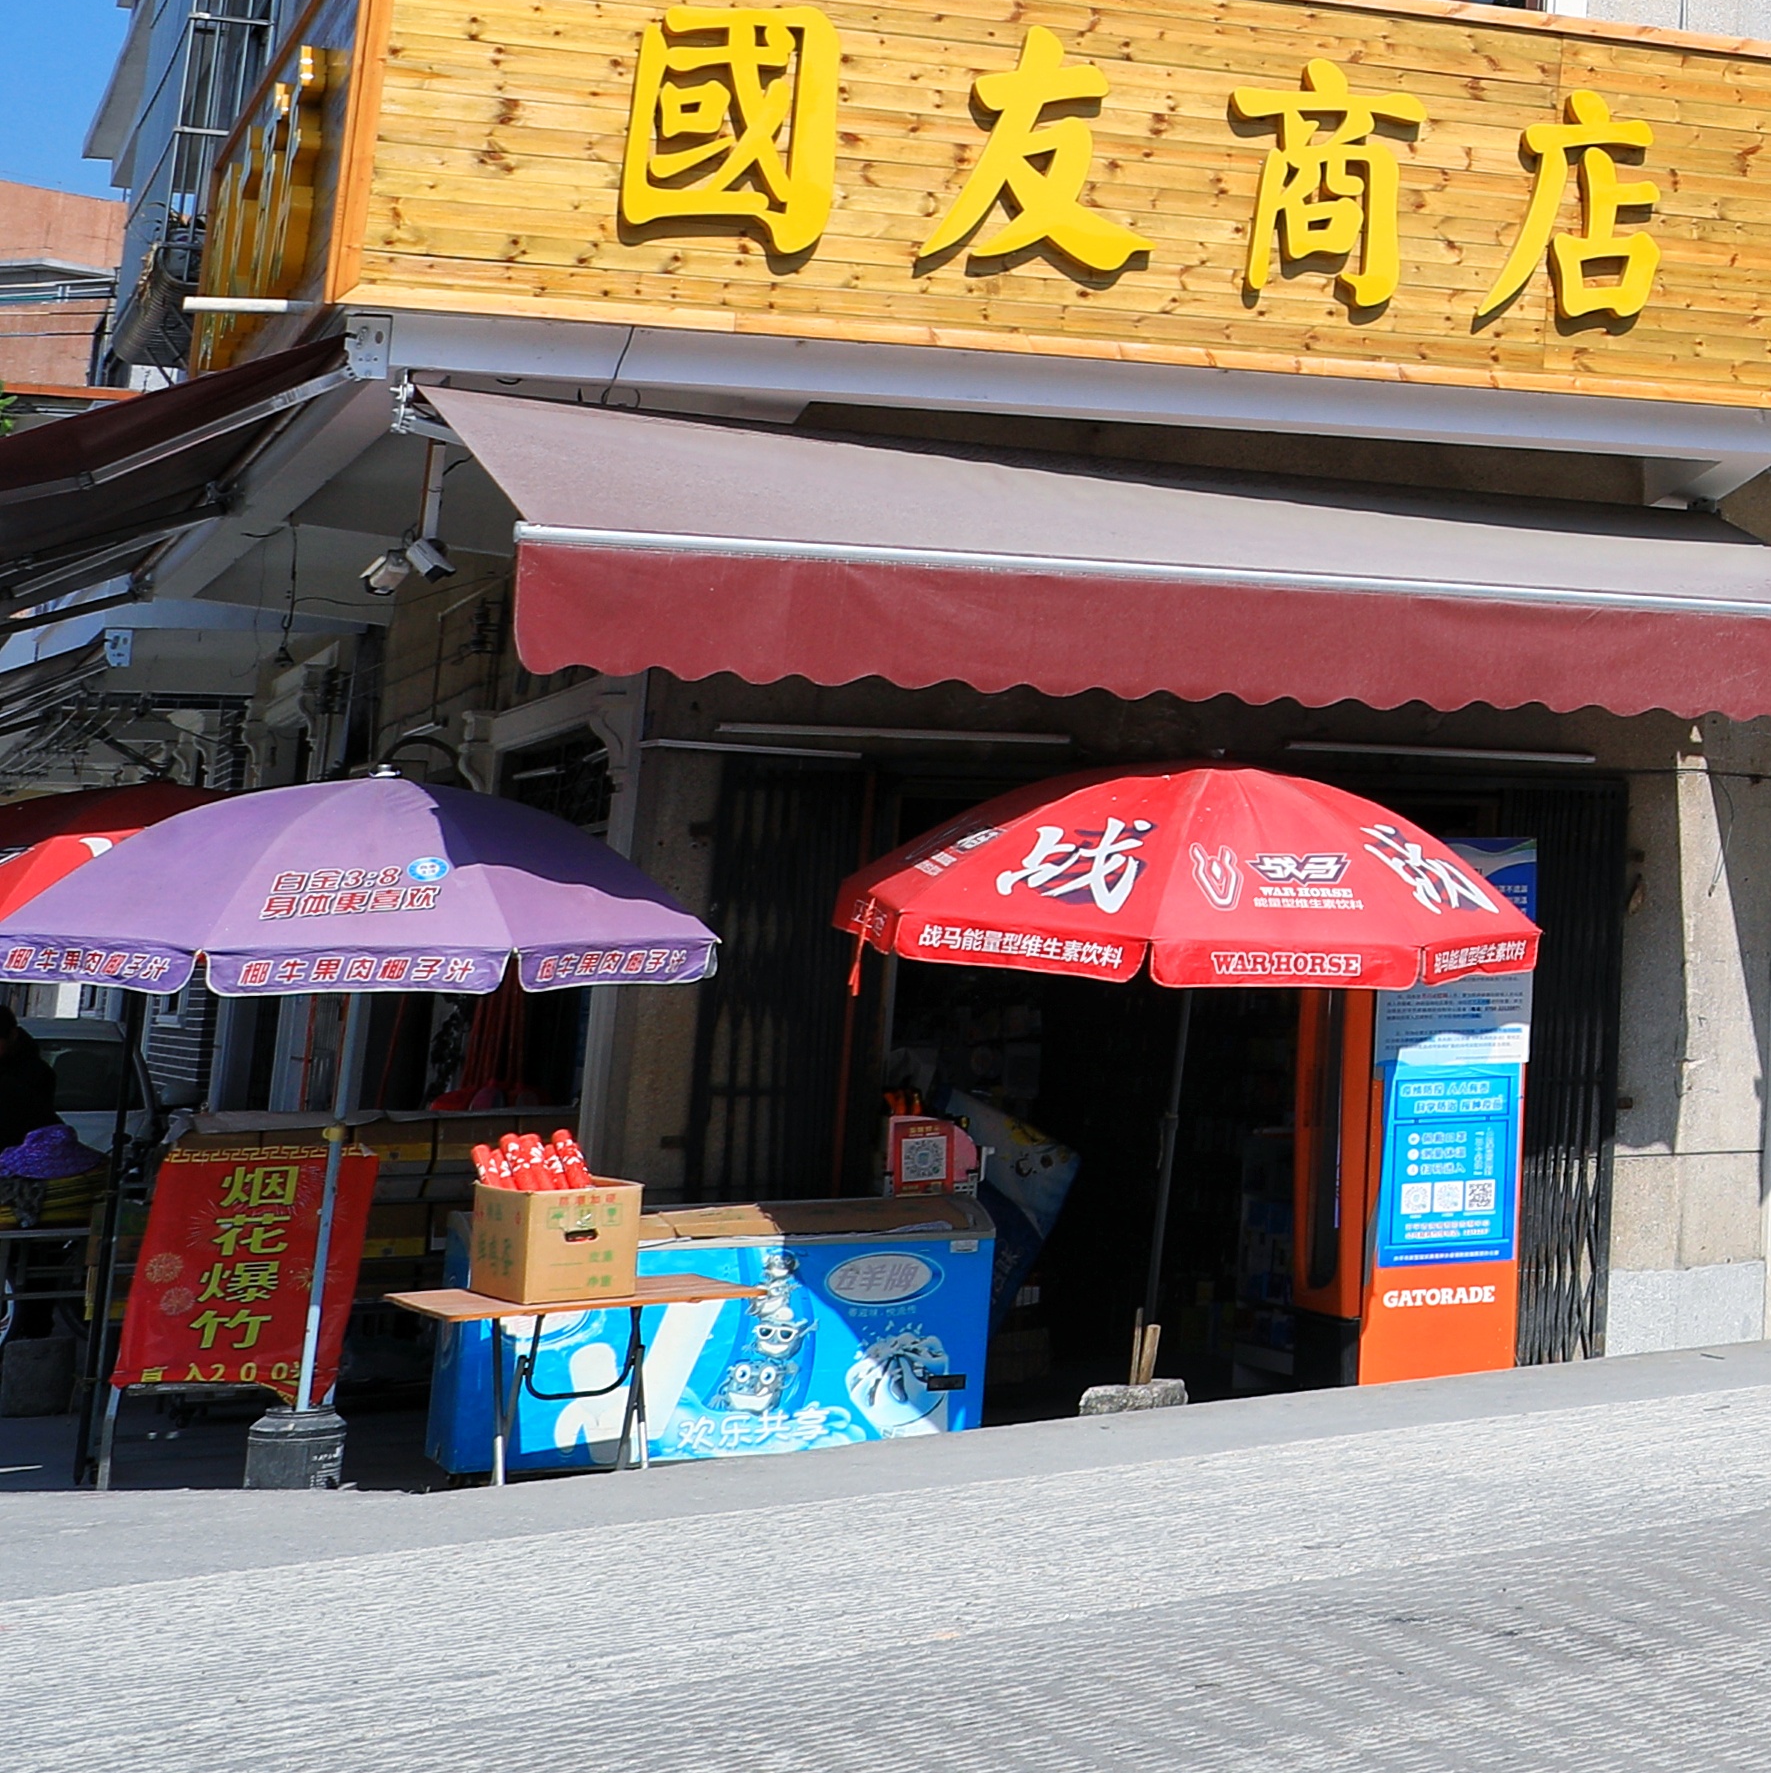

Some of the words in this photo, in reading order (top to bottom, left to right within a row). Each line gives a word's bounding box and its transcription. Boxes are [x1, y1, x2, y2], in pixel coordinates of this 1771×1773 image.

[620, 5, 1661, 320] 國友商店
[271, 866, 402, 894] 白金3:8
[996, 816, 1152, 914] 战
[1254, 854, 1346, 882] 战马
[259, 886, 442, 920] 身体更喜欢
[1253, 897, 1364, 910] 能量型维生素饮料
[1259, 886, 1296, 898] WAR
[1299, 886, 1353, 899] HORSE
[918, 924, 1123, 970] 战马能量型维生素饮料
[3, 946, 171, 982] 椰牛果肉椰子汁
[237, 956, 476, 987] 椰牛果肉椰子汁
[535, 949, 688, 982] 椰牛果肉椰子汁
[1211, 952, 1270, 975] WAR
[1273, 953, 1362, 976] HORSE
[189, 1165, 300, 1349] 烟花爆竹
[1383, 1286, 1496, 1309] GATORADE
[677, 1404, 834, 1451] 欢乐共享
